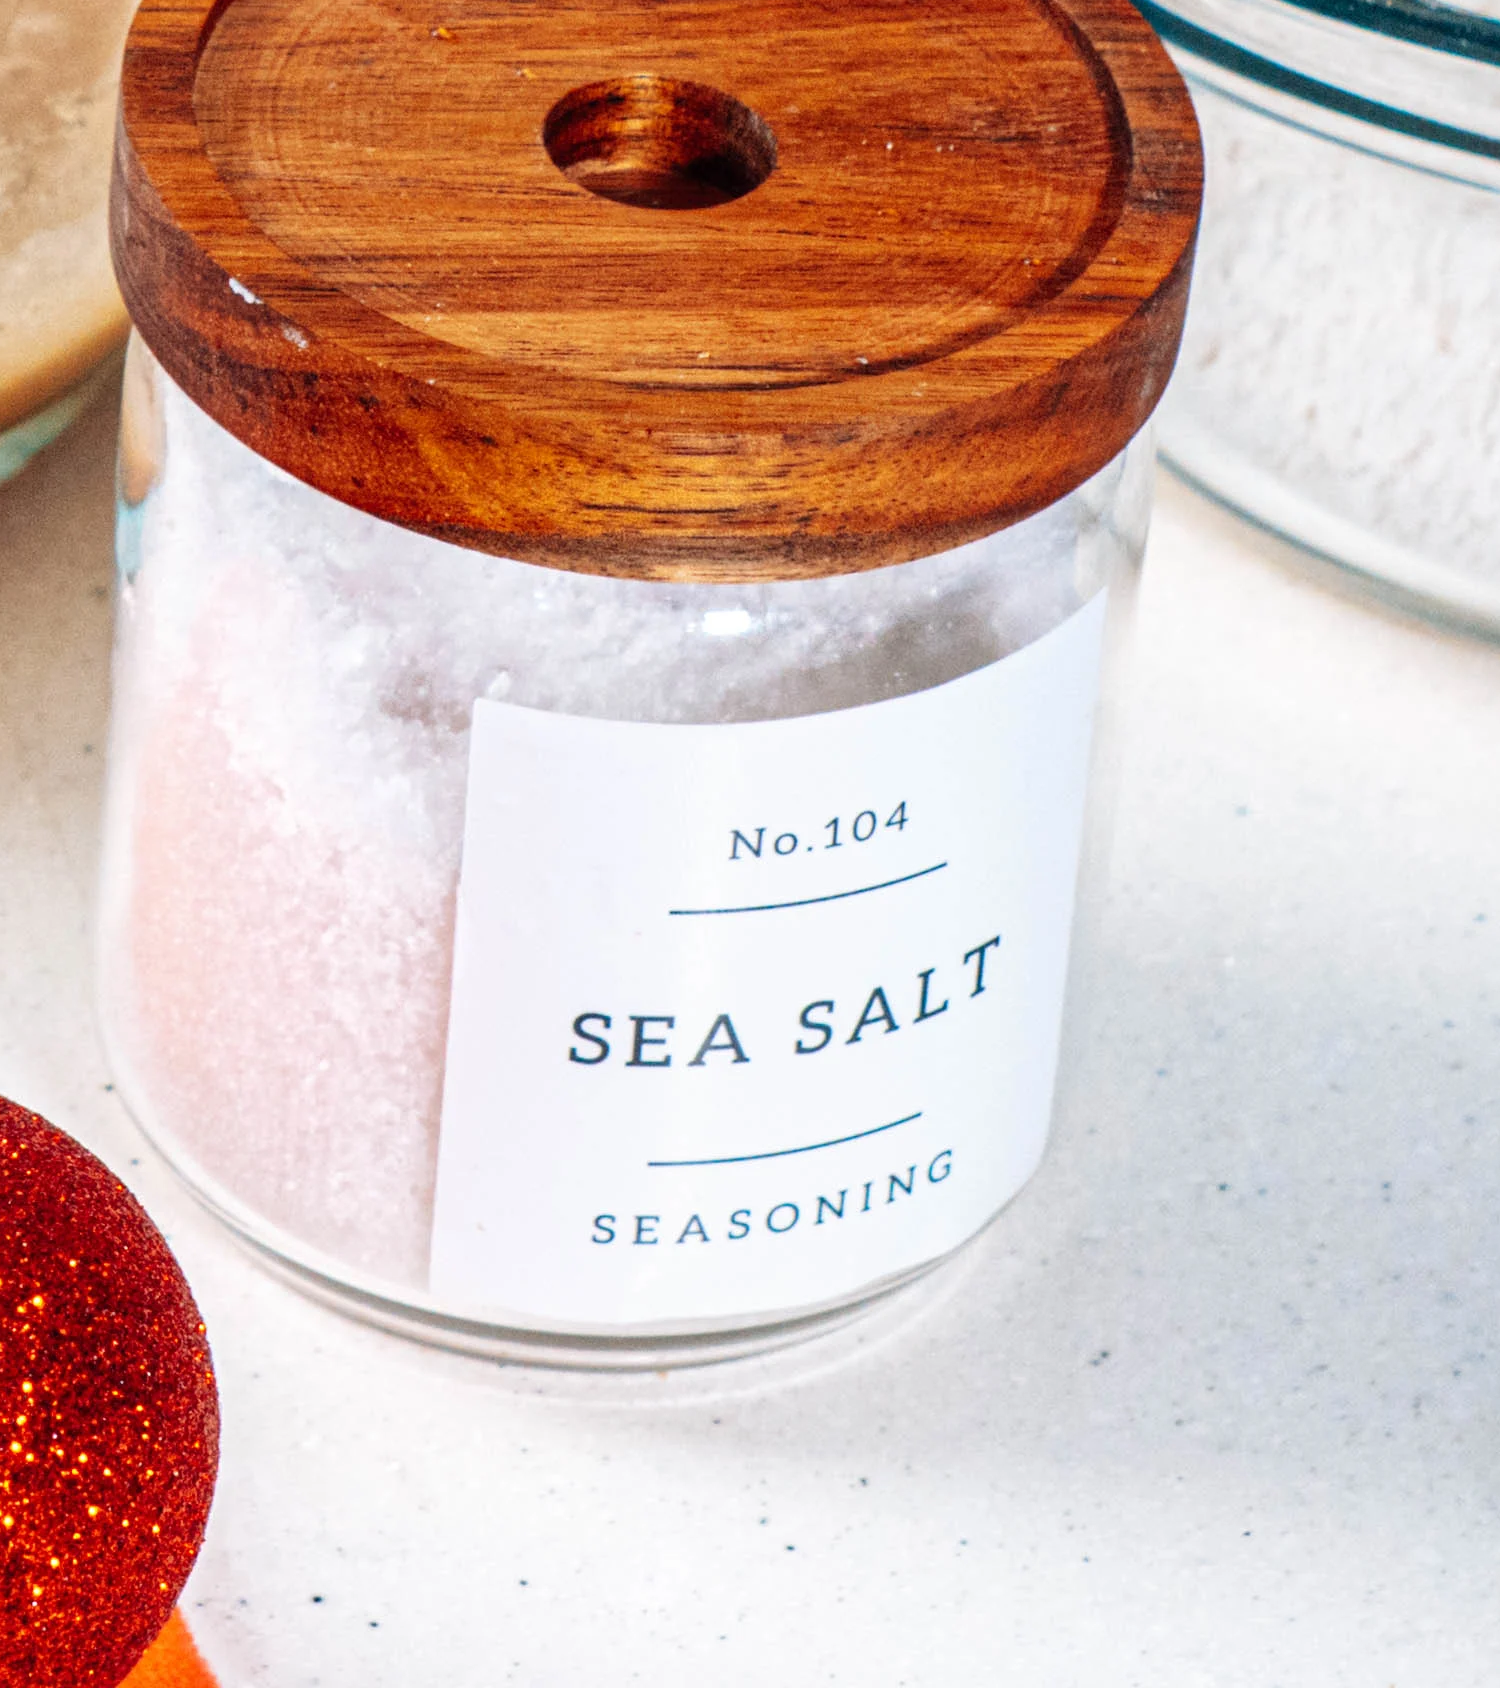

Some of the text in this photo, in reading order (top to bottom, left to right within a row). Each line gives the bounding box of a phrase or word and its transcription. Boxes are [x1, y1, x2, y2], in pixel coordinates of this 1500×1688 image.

[728, 799, 911, 862] No.104
[568, 935, 1002, 1069] SEA SALT
[591, 1149, 955, 1246] SEASONING
